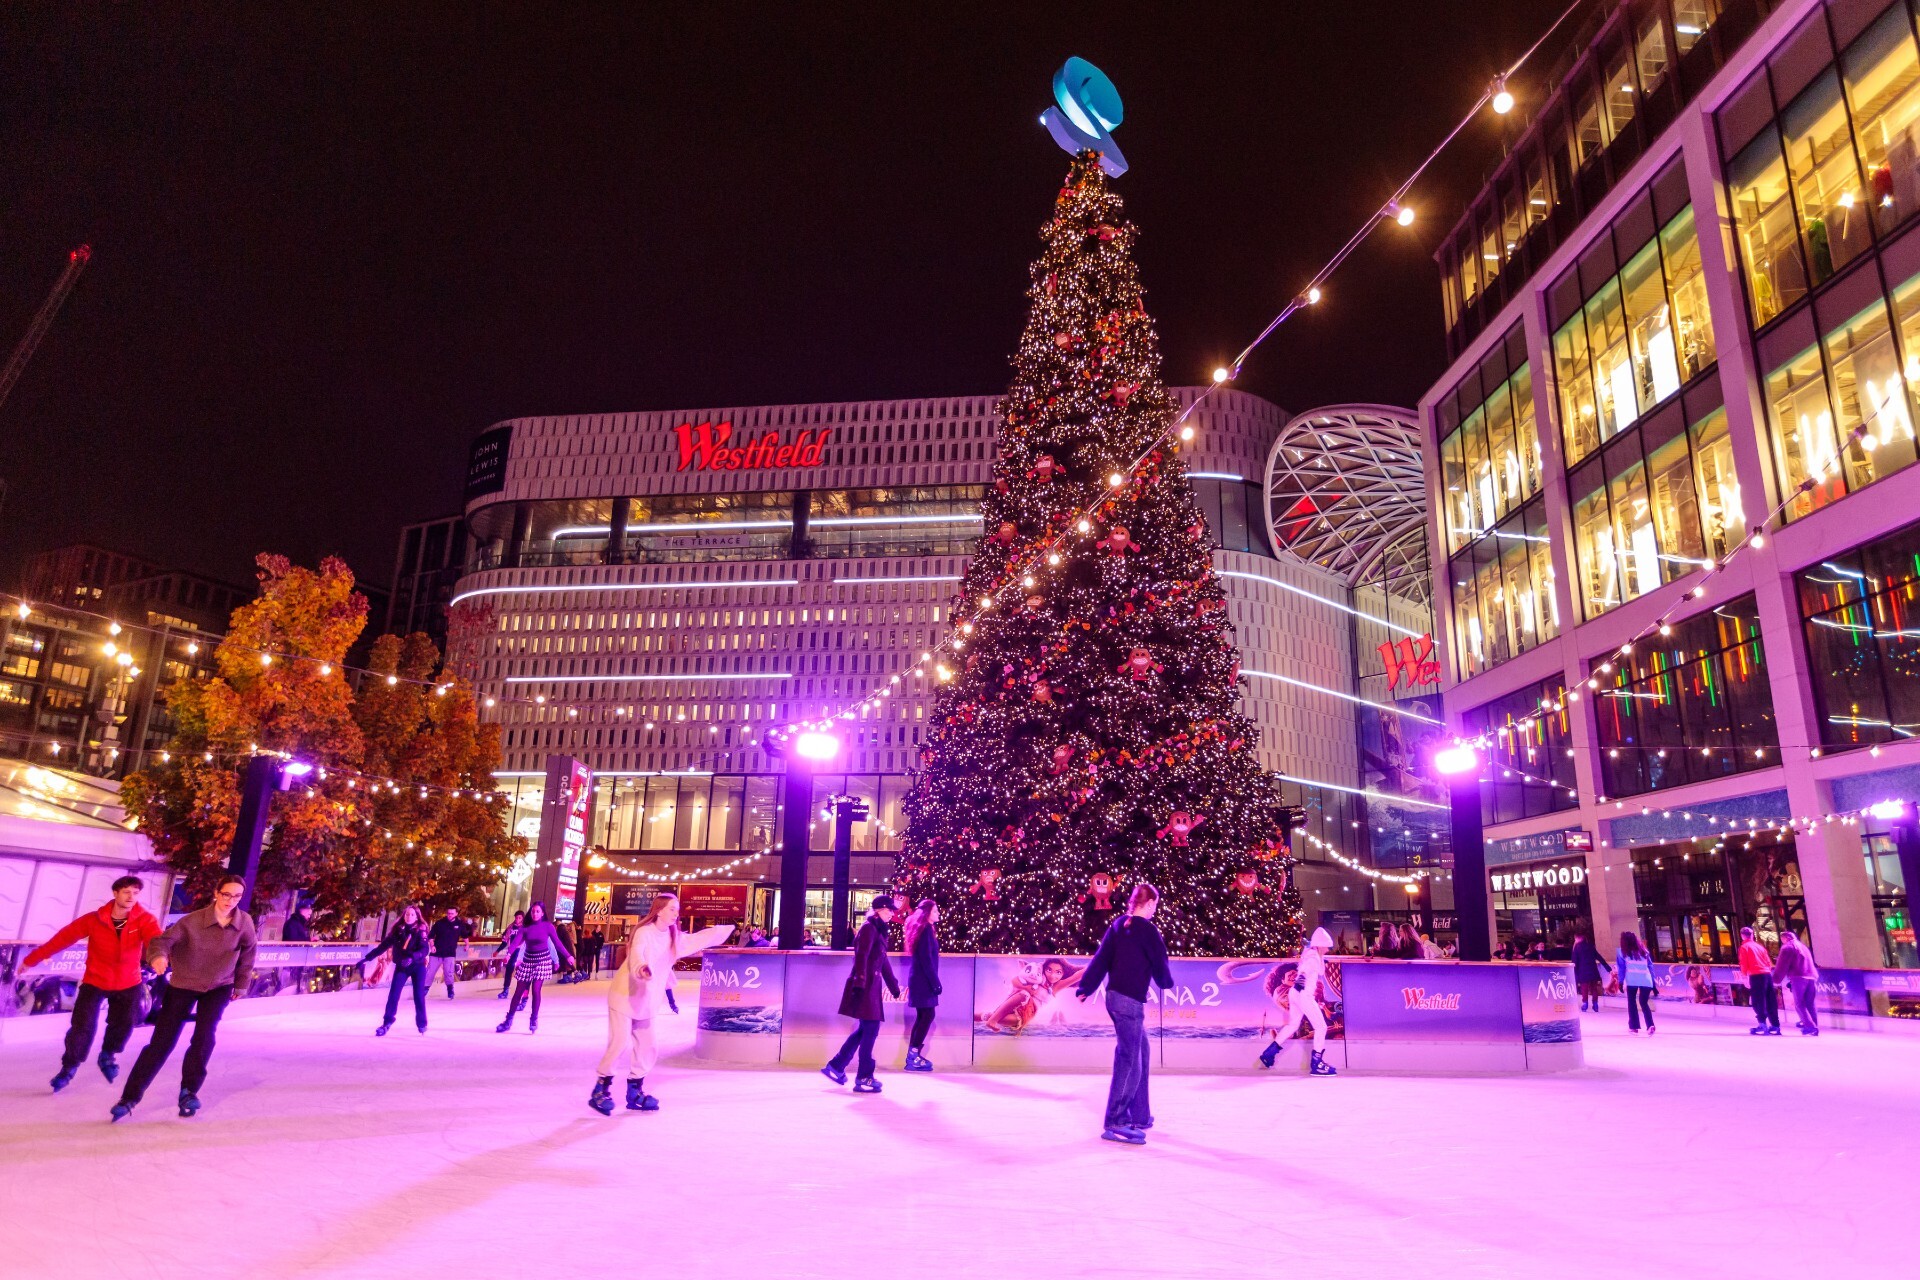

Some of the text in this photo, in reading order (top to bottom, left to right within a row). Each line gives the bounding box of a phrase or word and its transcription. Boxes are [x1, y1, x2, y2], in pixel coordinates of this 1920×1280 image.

[475, 442, 498, 459] JOHN
[673, 421, 833, 472] Westfield
[470, 457, 498, 475] LEWIS
[692, 537, 741, 546] TERRACE
[558, 775, 569, 806] OCEAN
[1501, 833, 1564, 852] WESTWOOD
[1491, 866, 1584, 891] WESTWOOD
[62, 950, 87, 960] FIRST
[259, 952, 291, 961] SKATE AID
[320, 951, 362, 960] SKATE DIRECTION
[51, 961, 73, 971] LOST
[742, 966, 762, 989] 2
[1665, 974, 1673, 987] 2
[1200, 982, 1222, 1007] 2
[1838, 981, 1848, 994] 2
[1401, 987, 1461, 1010] Westfield
[1179, 1010, 1197, 1018] VUE
